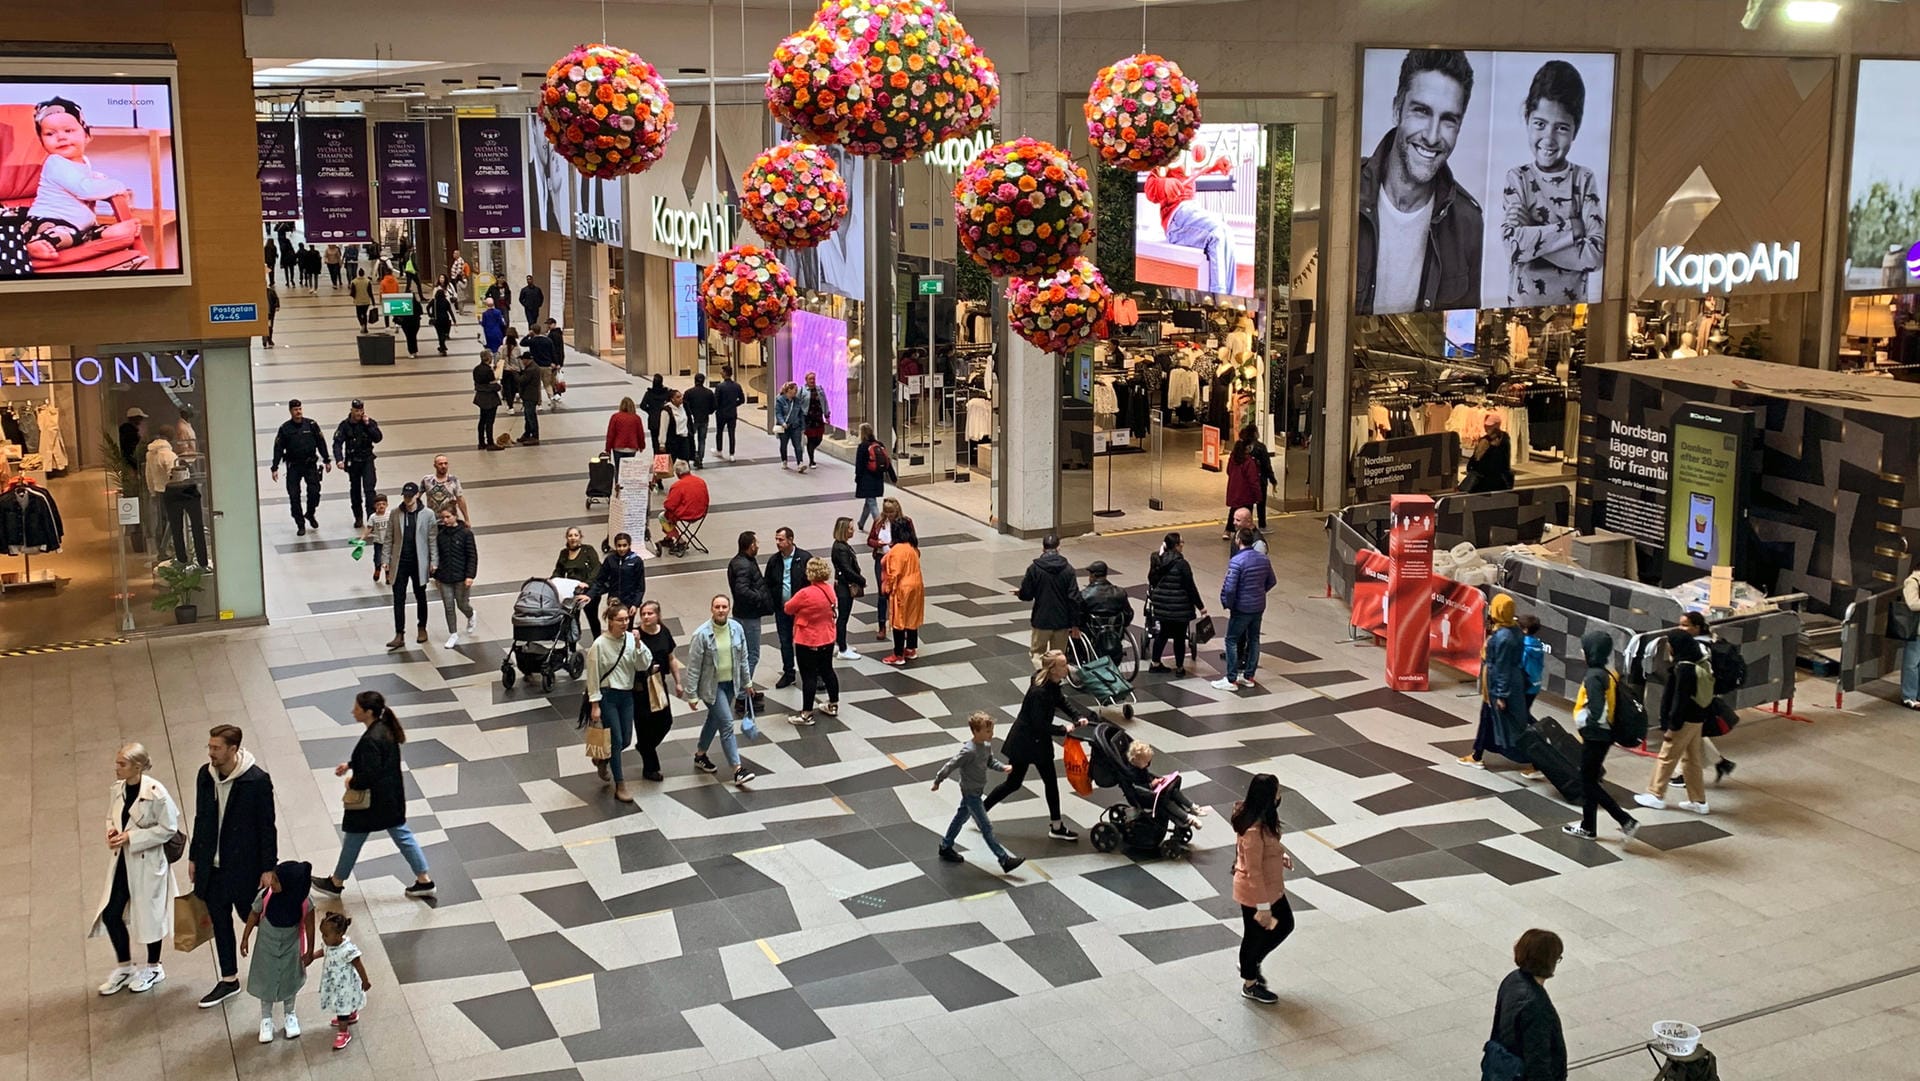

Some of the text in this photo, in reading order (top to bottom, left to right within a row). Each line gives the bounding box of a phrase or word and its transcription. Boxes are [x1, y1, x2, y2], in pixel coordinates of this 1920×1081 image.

[107, 97, 155, 106] lindex.com
[652, 195, 730, 259] KappAhl
[1655, 240, 1801, 294] KappAhl
[212, 306, 254, 314] Postgatan
[75, 354, 200, 385] ONLY
[1611, 419, 1667, 443] Nordstan
[1610, 437, 1649, 458] lägger
[1364, 455, 1394, 465] Nordstan
[1609, 455, 1627, 471] för
[1385, 463, 1412, 474] grunden
[1374, 474, 1404, 485] framtiden
